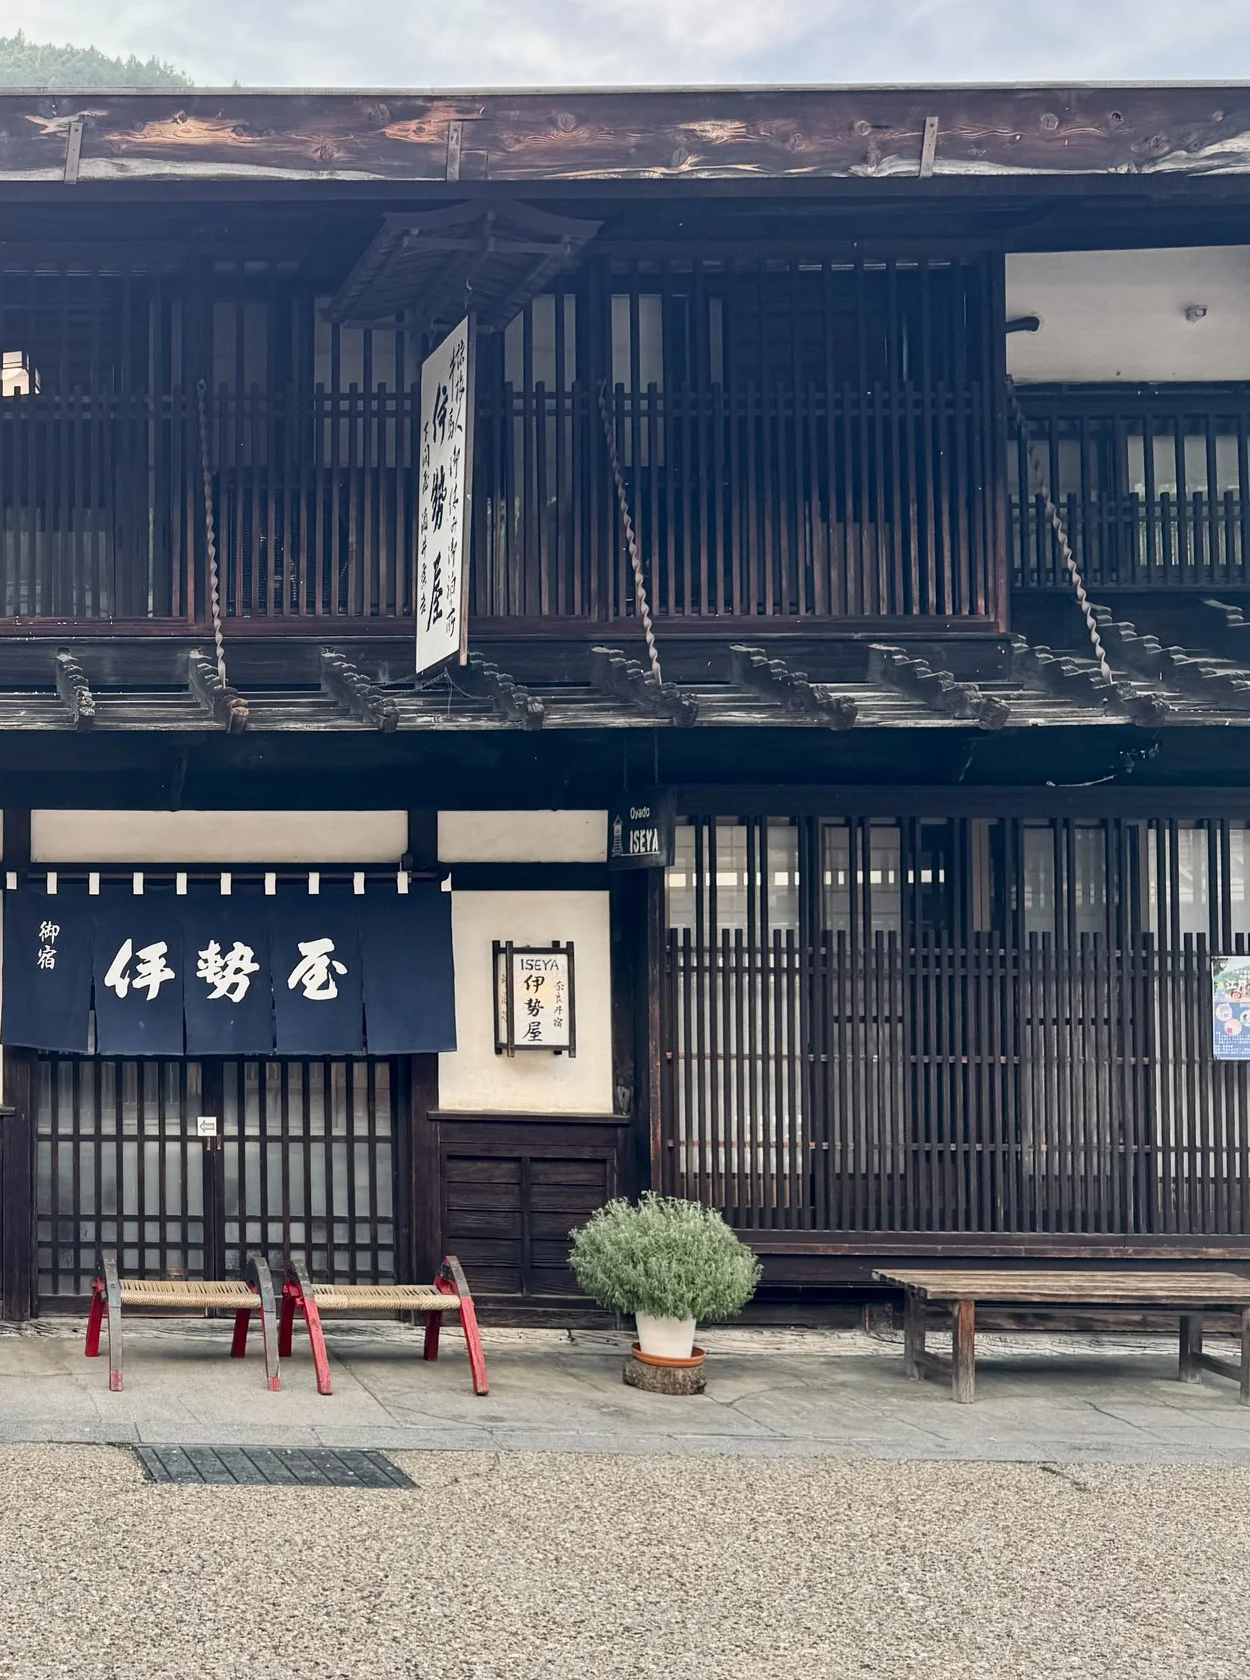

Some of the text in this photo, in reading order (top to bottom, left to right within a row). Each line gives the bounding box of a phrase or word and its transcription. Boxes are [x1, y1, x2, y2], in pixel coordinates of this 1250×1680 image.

[426, 382, 448, 633] 伊勢屋
[630, 806, 650, 820] Oyado
[630, 828, 659, 853] ISEYA
[37, 921, 60, 970] 御宿
[520, 958, 559, 971] ISEYA
[105, 937, 348, 1003] 伊勢屋
[523, 974, 545, 1042] 伊勢屋
[553, 980, 565, 1028] 奈良井宿
